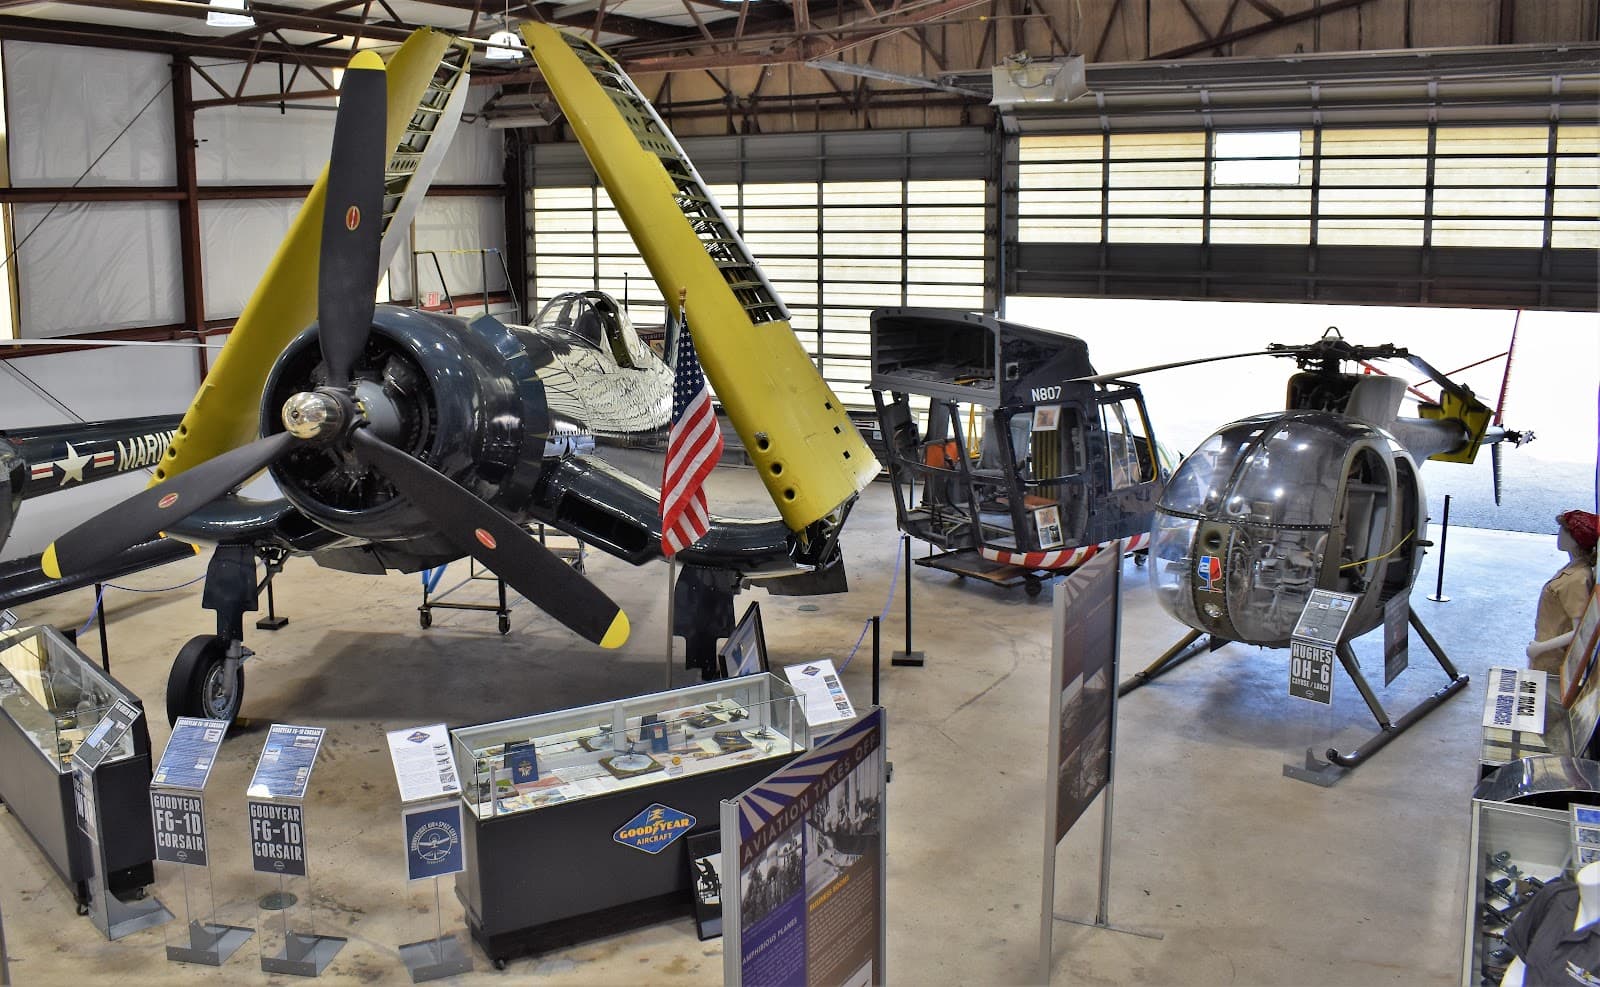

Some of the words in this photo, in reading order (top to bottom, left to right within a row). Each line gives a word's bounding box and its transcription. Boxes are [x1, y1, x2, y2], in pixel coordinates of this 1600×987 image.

[1031, 386, 1062, 402] N807
[117, 430, 177, 471] MARIN
[1293, 643, 1331, 663] HUGHES
[1292, 658, 1330, 684] OH-6
[153, 795, 201, 812] GOODYEAR
[250, 804, 300, 821] GOODYEAR
[744, 794, 809, 863] AVIATION
[814, 759, 851, 798] TAKES
[156, 809, 202, 834] FG-1D
[252, 819, 301, 844] FG-1D
[620, 818, 690, 839] GOODYEAR
[158, 832, 204, 851] CORSAIR
[636, 832, 673, 846] AIRCRAFT
[254, 841, 303, 861] CORSAIR
[742, 933, 777, 965] AMPHIBIOUS
[777, 917, 798, 937] PLANES
